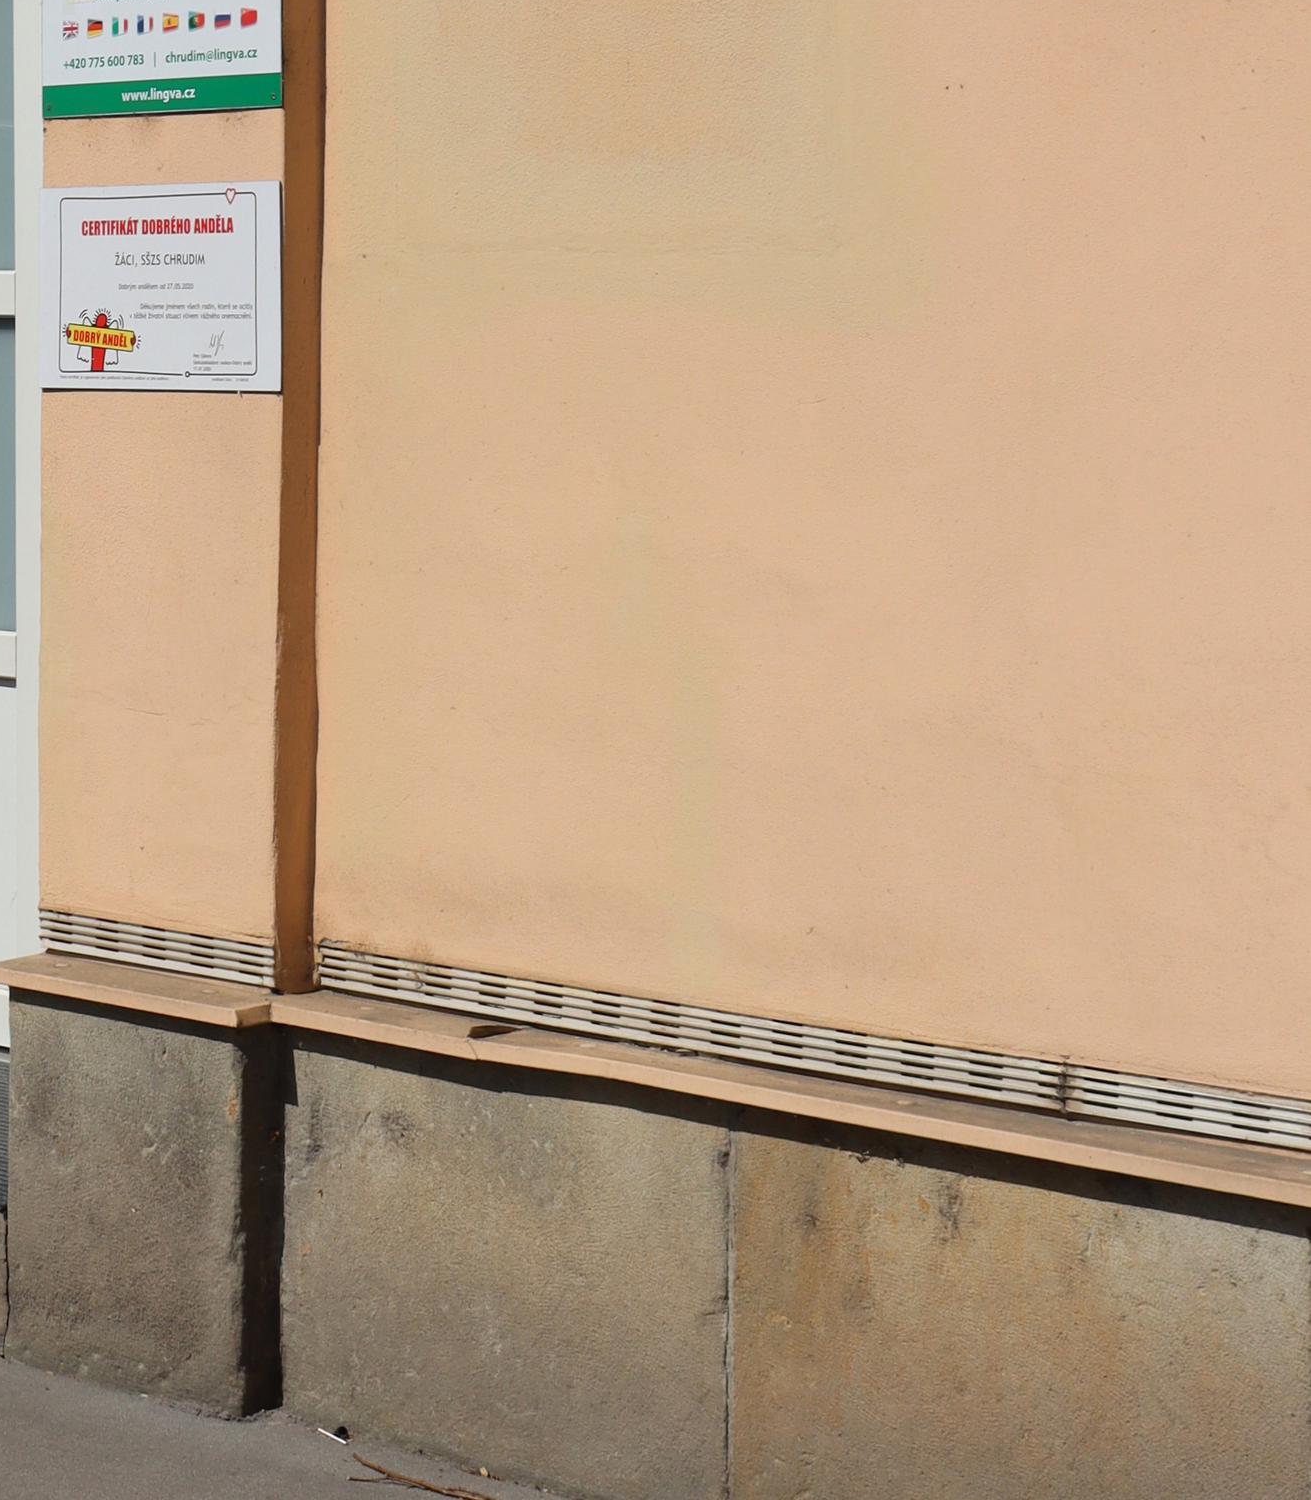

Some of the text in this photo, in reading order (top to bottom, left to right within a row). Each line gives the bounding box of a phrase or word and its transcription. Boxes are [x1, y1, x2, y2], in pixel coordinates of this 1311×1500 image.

[63, 47, 258, 69] +420 775 600 783 chrudim@lingva.cz
[121, 86, 196, 103] www.lingva.cz
[81, 214, 234, 236] CERTIFIKÁT DOBRÉHO ANDĚLA
[114, 252, 205, 267] ŽÁCI, SŠZS CHRUDIM
[73, 328, 128, 348] DOBRÝ ANDĚL
